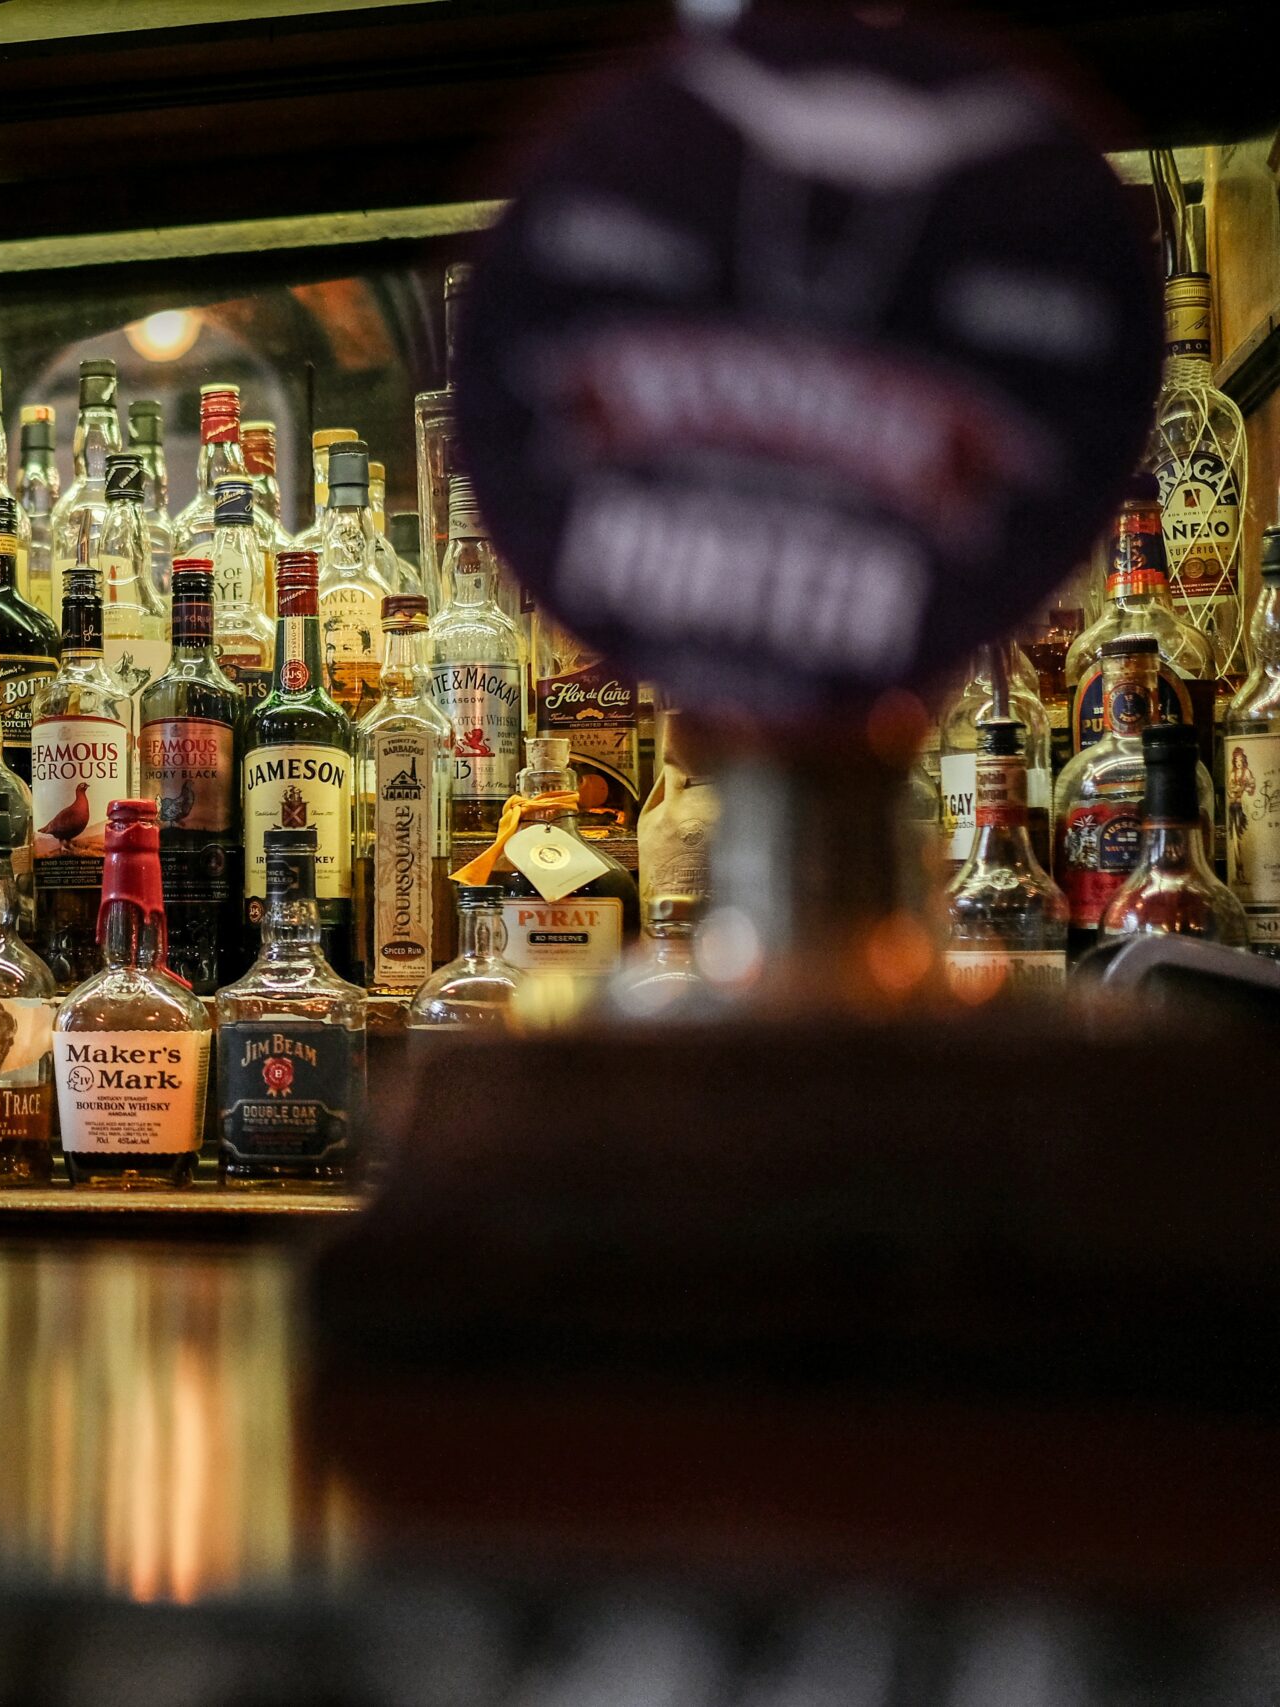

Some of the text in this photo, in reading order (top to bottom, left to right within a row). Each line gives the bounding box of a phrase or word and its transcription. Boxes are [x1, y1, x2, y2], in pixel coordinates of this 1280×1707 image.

[465, 667, 520, 707] MACKAY
[545, 681, 631, 709] Flor de Caña
[152, 739, 218, 754] FAMOUS
[614, 732, 628, 748] 7
[37, 743, 119, 763] FAMOUS
[152, 752, 218, 767] GROUSE
[383, 745, 424, 756] BARBADOS
[36, 761, 119, 781] GROUSE
[145, 770, 218, 780] SMOKY BLACK
[247, 759, 344, 790] JAMESON
[950, 793, 974, 816] GAY
[393, 805, 415, 937] FOURSQUARE
[518, 910, 598, 927] PYRAT
[383, 947, 422, 955] SPICED RUM
[66, 1044, 182, 1064] Maker's
[241, 1034, 317, 1067] JIM BEAM
[97, 1070, 182, 1089] Mark
[3, 1090, 41, 1117] TRACE
[76, 1101, 171, 1111] BOURBON WHISKY
[243, 1105, 317, 1118] DOUBLE OAK
